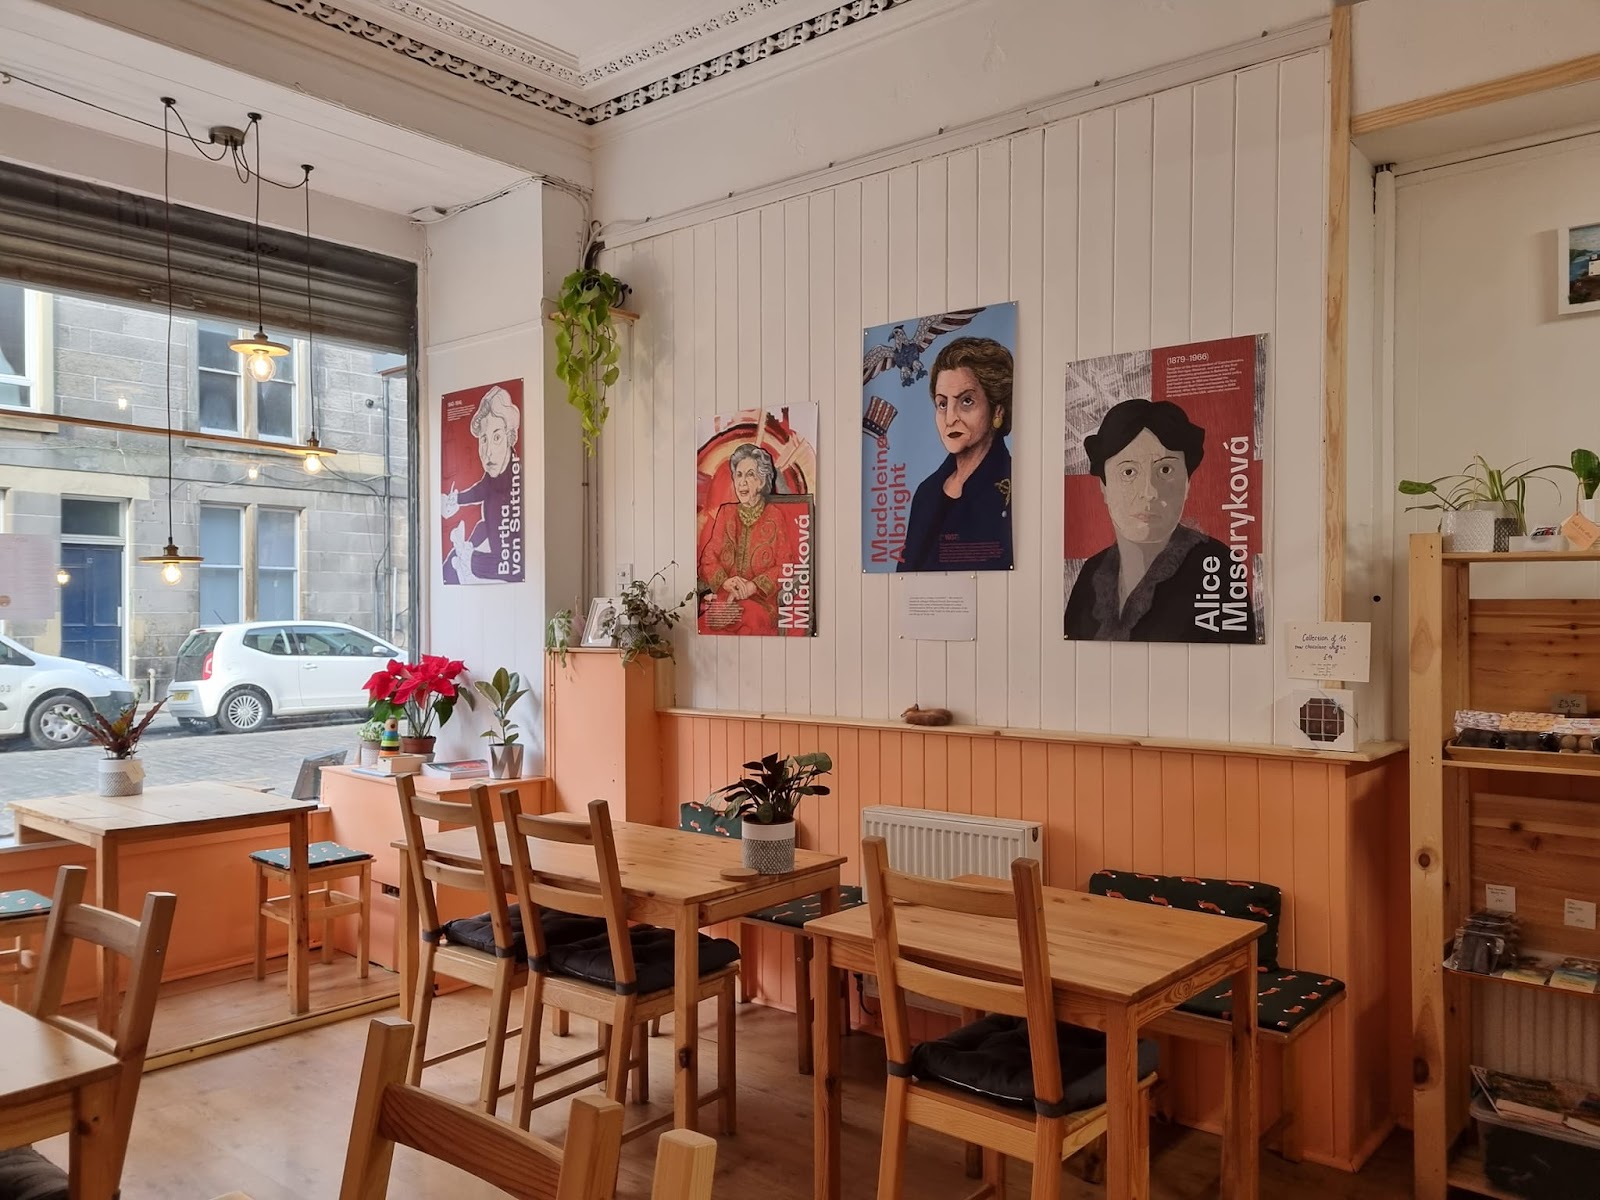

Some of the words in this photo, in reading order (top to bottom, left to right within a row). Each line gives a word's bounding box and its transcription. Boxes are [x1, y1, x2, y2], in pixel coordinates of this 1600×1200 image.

[509, 453, 521, 532] Suttner
[871, 434, 888, 562] Madeleine
[889, 462, 911, 563] Albright
[498, 505, 510, 575] Bertha
[512, 537, 521, 575] von
[794, 514, 810, 629] Mládková
[1222, 436, 1255, 631] Masaryková
[778, 563, 794, 629] Meda
[1194, 555, 1221, 633] Alice
